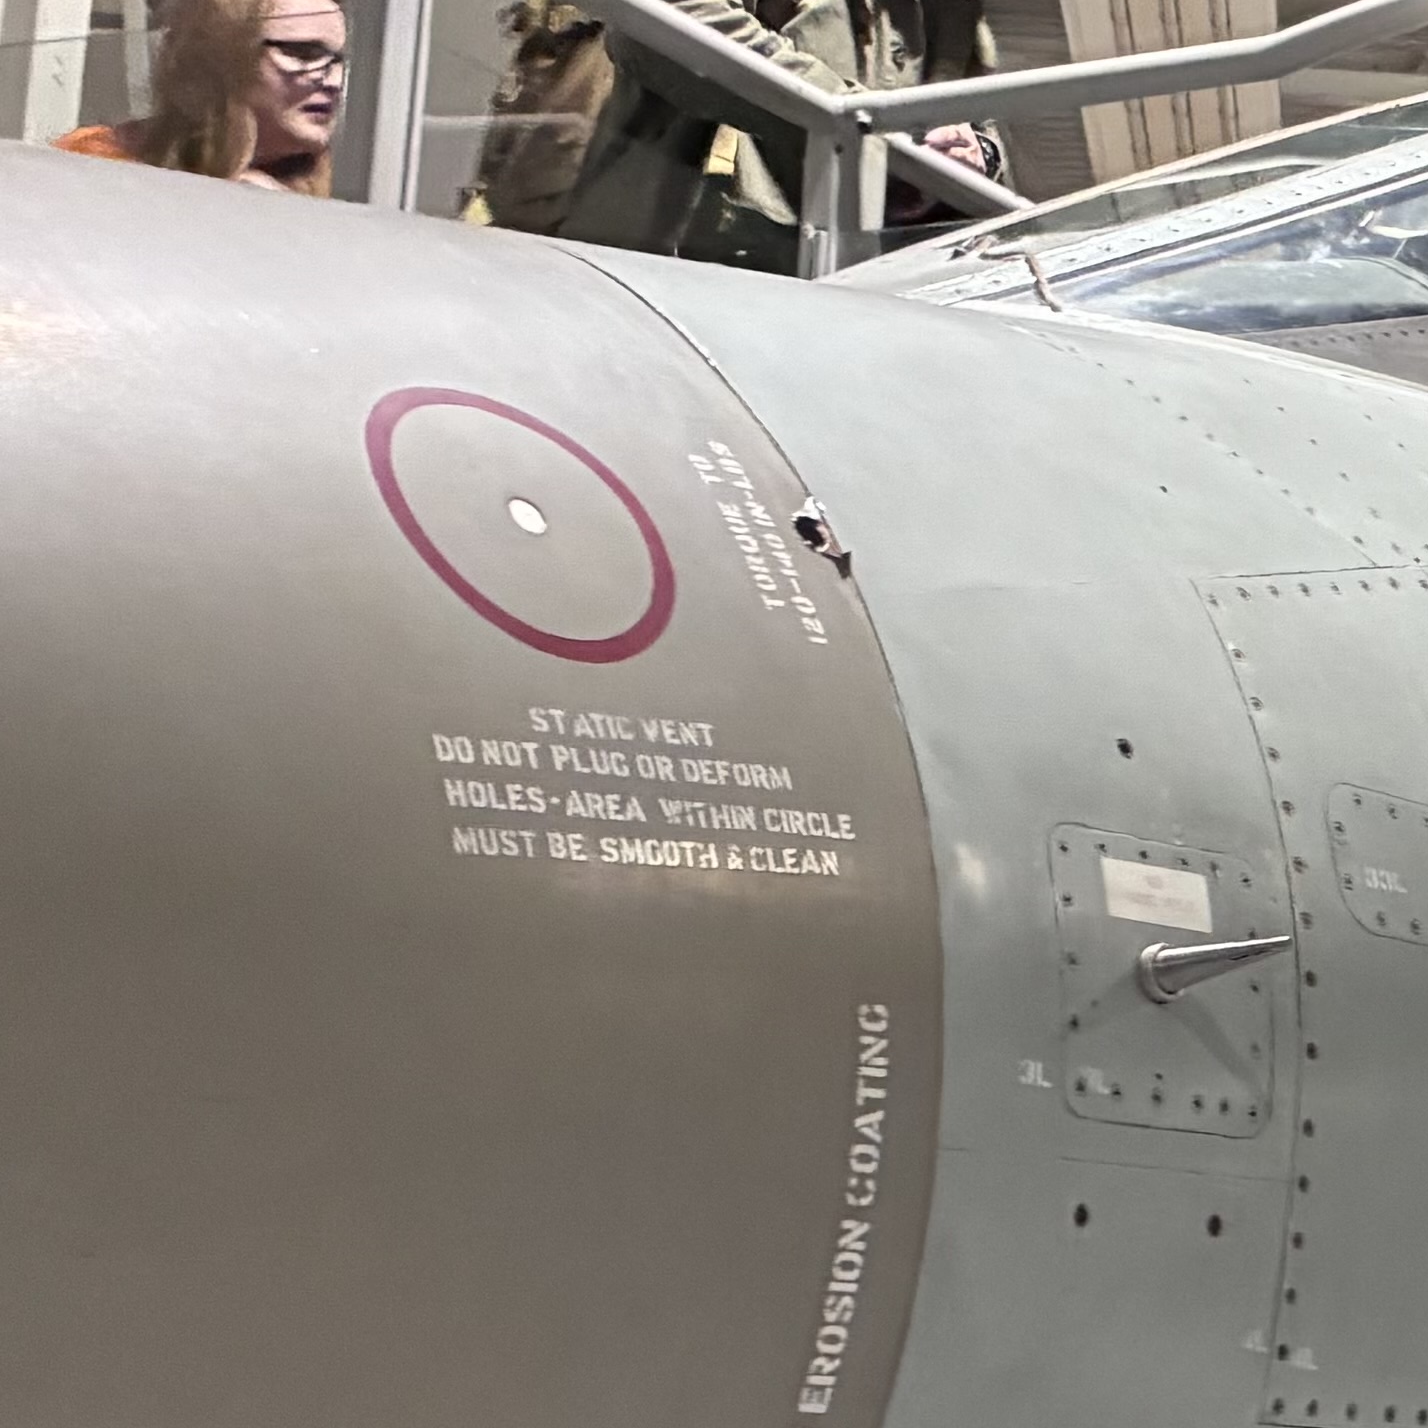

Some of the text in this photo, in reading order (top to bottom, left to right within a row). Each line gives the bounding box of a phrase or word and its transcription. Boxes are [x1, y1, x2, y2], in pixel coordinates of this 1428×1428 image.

[688, 453, 786, 611] TORQUE TO
[528, 706, 715, 748] STATIC VENT
[432, 733, 794, 791] DO NOT PLUG OR DEFORM
[658, 797, 758, 832] WITHIN
[762, 807, 857, 841] CIRCLE
[452, 827, 841, 877] MUST BE SMOOTH & CLEAN
[797, 1218, 872, 1415] EROSION
[845, 1003, 890, 1209] COATING
